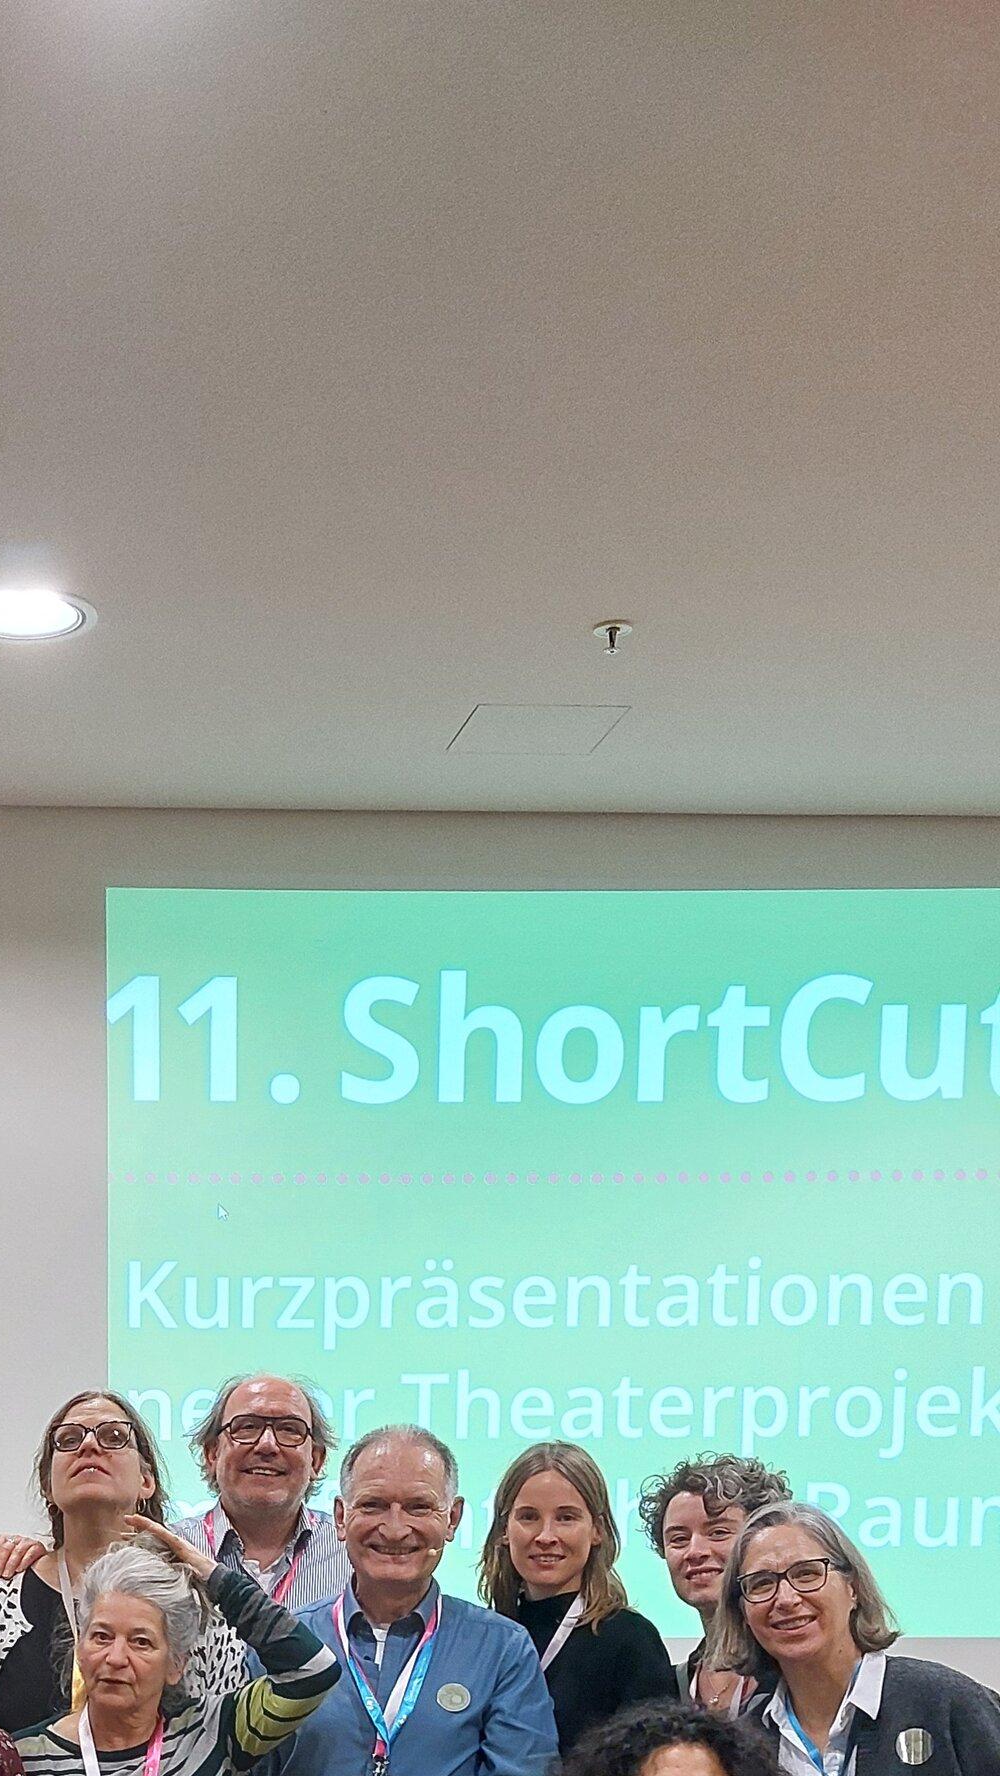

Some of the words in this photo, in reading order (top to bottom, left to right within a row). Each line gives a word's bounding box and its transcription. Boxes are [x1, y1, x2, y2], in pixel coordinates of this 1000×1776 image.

[106, 974, 301, 1106] 11.
[126, 1257, 985, 1352] Kurzpräsentationen
[129, 1386, 376, 1441] ner
